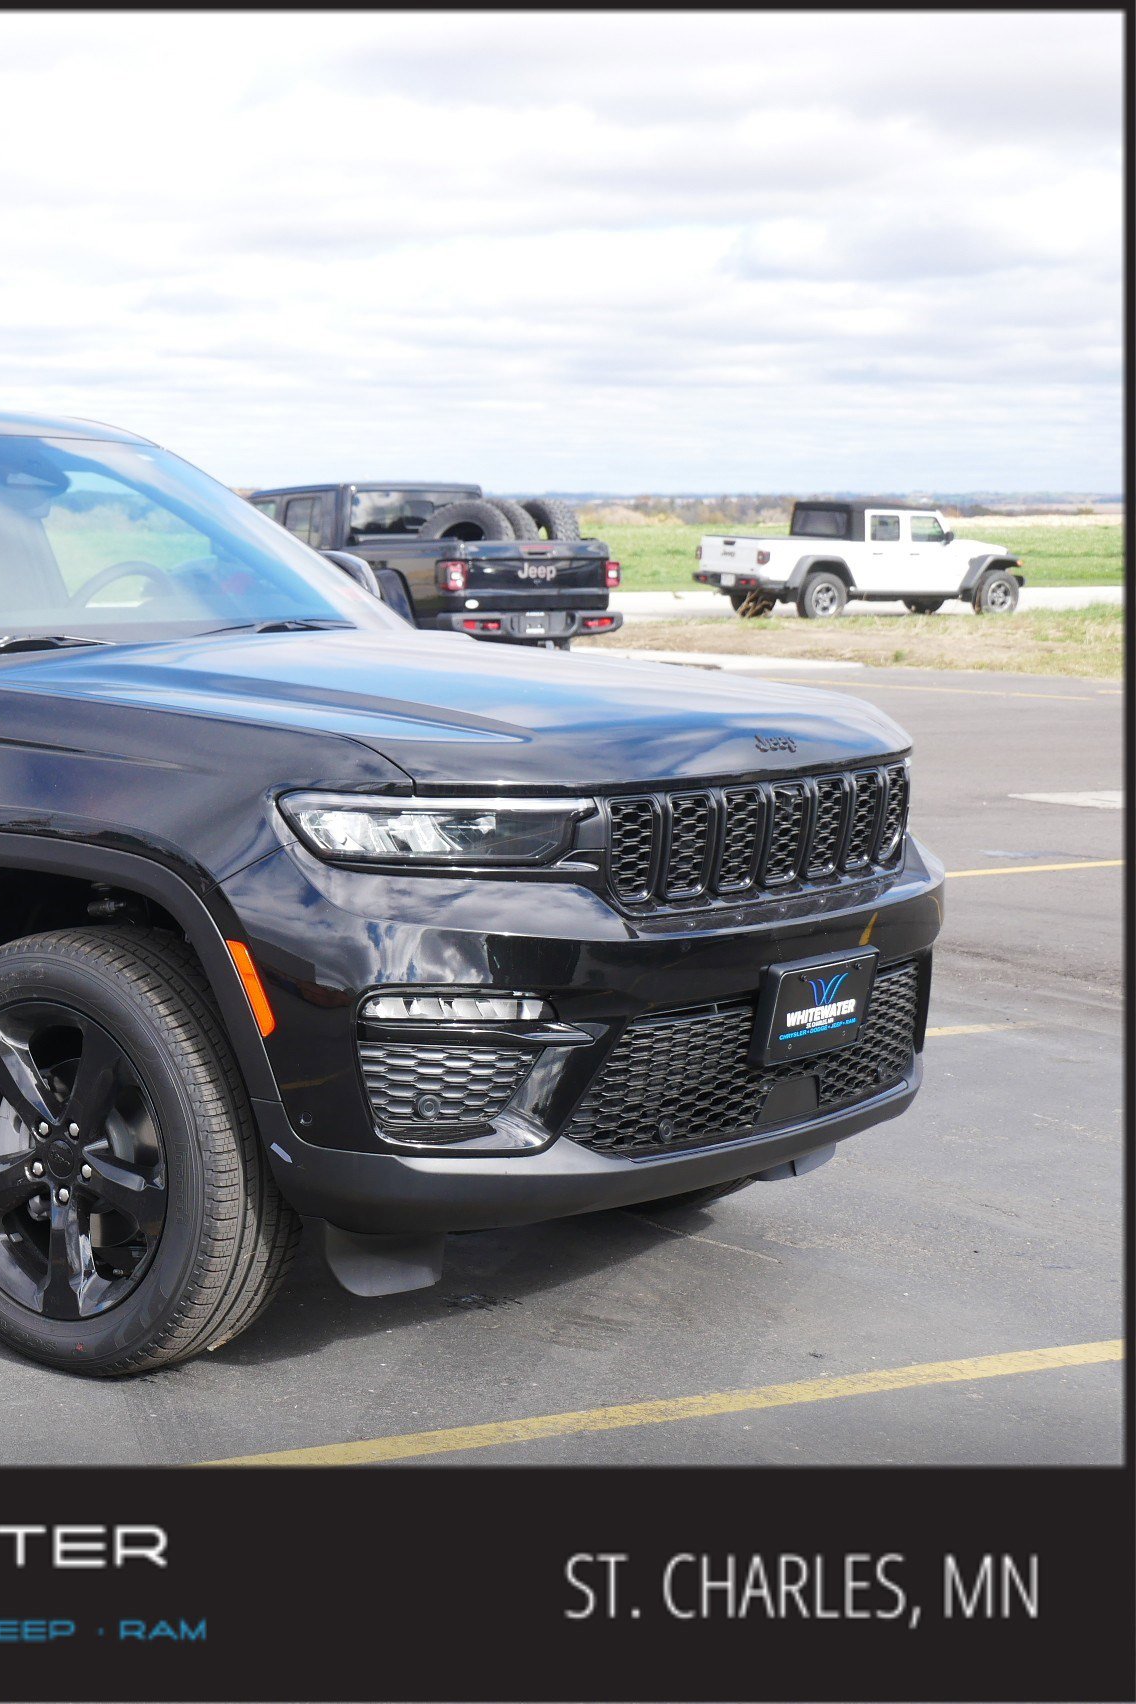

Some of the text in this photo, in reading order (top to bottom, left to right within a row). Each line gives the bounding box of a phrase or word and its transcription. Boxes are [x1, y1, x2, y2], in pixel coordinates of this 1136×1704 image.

[517, 562, 557, 581] Jeep
[754, 734, 797, 753] Jeep
[786, 998, 856, 1027] WHITEWATER
[779, 1029, 807, 1040] CHRYSLER
